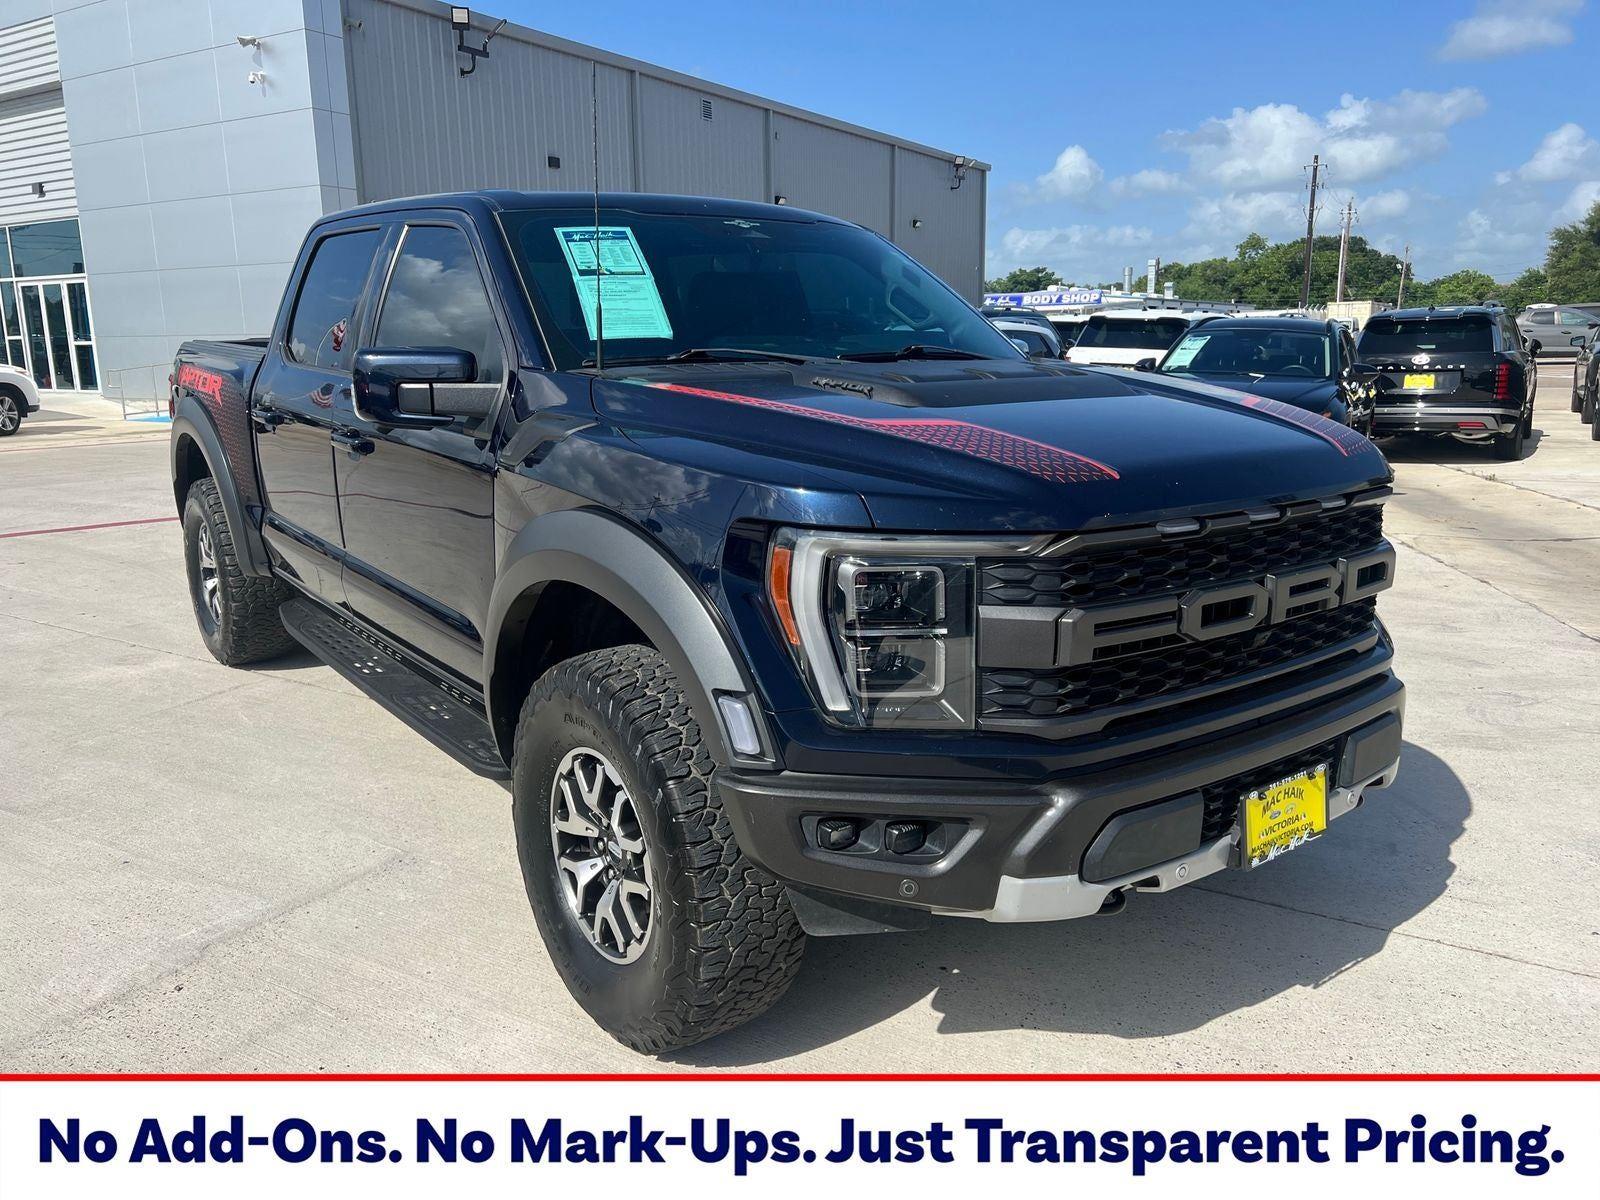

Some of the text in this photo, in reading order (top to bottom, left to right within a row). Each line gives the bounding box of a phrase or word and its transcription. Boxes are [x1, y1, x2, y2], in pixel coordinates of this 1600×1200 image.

[1023, 292, 1100, 305] BODY SHOP
[1059, 537, 1396, 665] FORD
[1261, 790, 1282, 818] MAC
[1283, 786, 1305, 801] HAIK
[1265, 815, 1300, 836] VICTORIA
